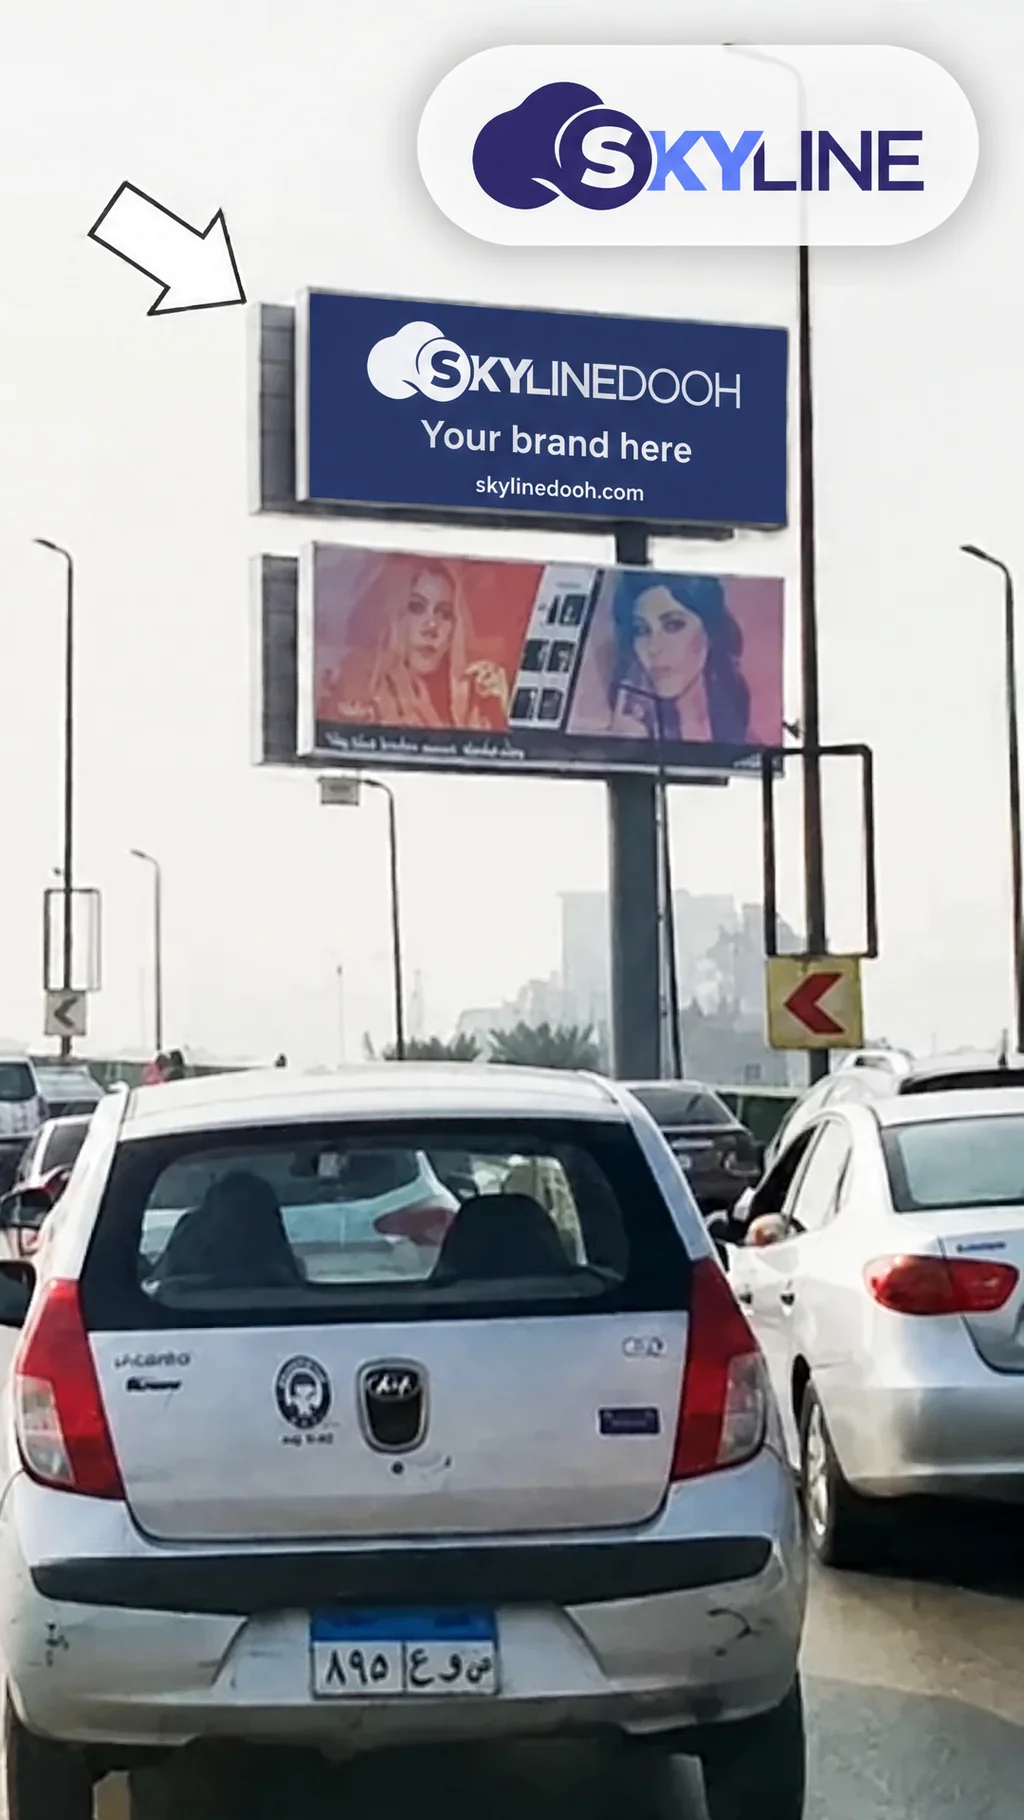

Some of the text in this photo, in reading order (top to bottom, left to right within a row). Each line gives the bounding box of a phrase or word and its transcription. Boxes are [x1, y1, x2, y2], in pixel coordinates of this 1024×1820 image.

[430, 350, 741, 409] SKYLINEDOOH
[420, 419, 692, 464] Your brand here
[476, 475, 644, 502] skylinedooh.com
[326, 1649, 390, 1686] ٨٩٥
